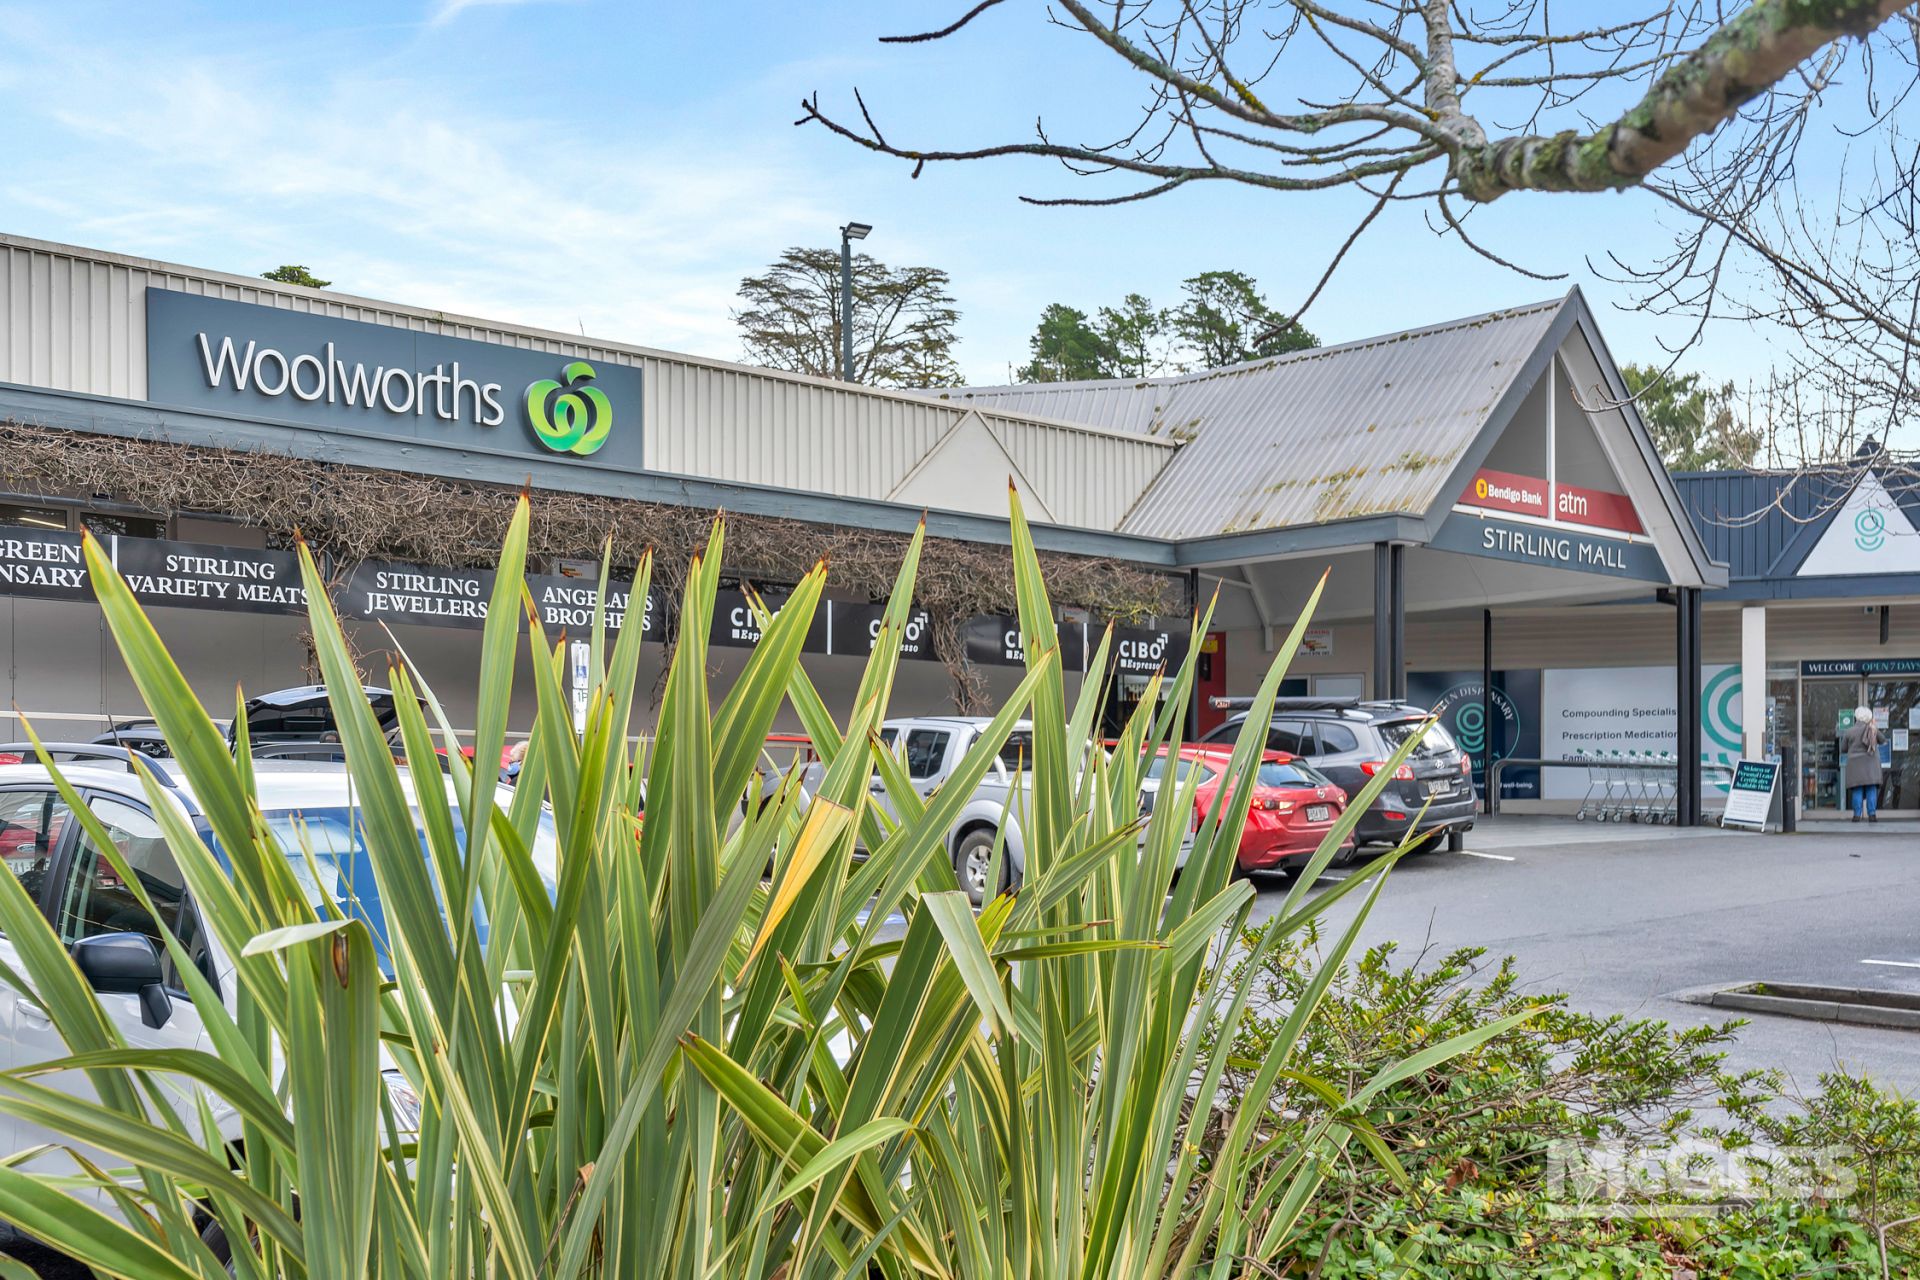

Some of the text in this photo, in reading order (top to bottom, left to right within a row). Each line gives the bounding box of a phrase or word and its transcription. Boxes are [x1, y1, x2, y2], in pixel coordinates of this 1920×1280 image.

[199, 333, 504, 426] Woolworths
[1488, 484, 1542, 505] Bendigo Bank
[1559, 491, 1587, 516] atm
[1482, 527, 1626, 569] STIRLING MALL
[166, 554, 275, 580] STIRLING
[126, 575, 309, 605] VARIETY MEATS
[376, 571, 480, 597] STIRLING
[365, 592, 488, 619] JEWELLERS
[1120, 640, 1161, 660] CIBO
[1127, 659, 1161, 671] Espresso
[1808, 662, 1857, 672] WELCOME
[1862, 662, 1889, 671] OPEN
[1890, 662, 1896, 671] 7
[1562, 707, 1677, 719] Compounding Specialis
[1562, 731, 1622, 741] Prescription
